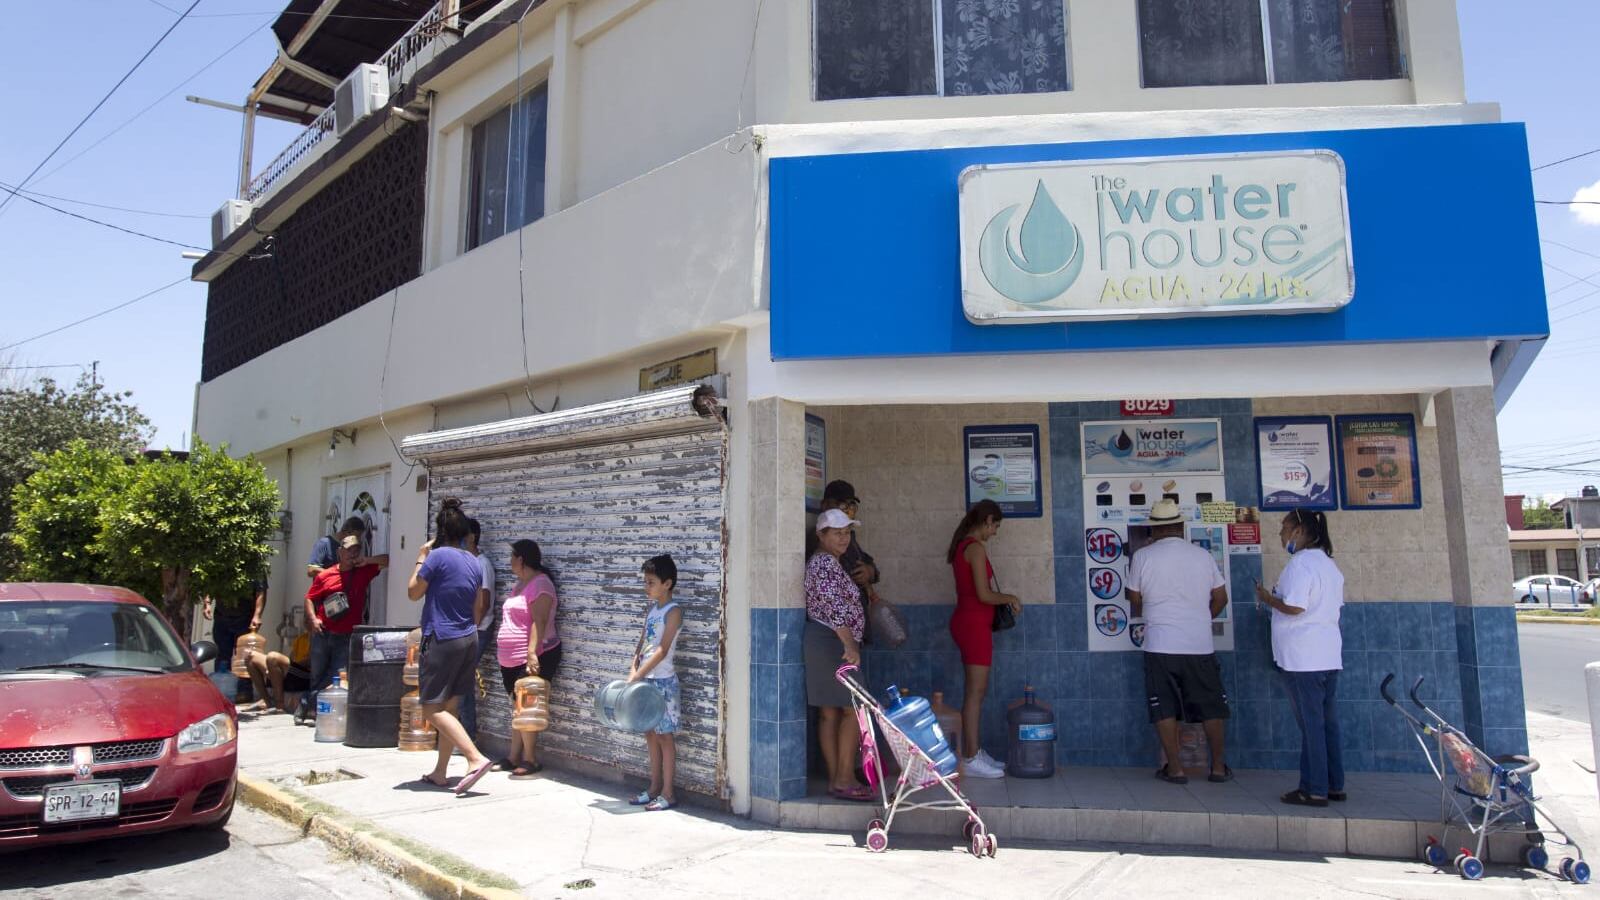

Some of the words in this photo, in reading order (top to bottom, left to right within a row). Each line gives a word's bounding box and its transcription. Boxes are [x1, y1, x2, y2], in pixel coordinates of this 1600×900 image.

[1091, 174, 1127, 192] The
[1107, 174, 1297, 225] water
[1100, 276, 1192, 303] AGUA
[1219, 273, 1254, 299] 24
[1262, 272, 1314, 299] hrs.
[1125, 399, 1170, 411] 8029
[1136, 432, 1186, 450] house
[1140, 428, 1185, 440] water
[1089, 533, 1117, 558] $15
[1095, 571, 1113, 594] $9
[1101, 609, 1117, 632] $5
[48, 791, 116, 812] SPR-12-44
